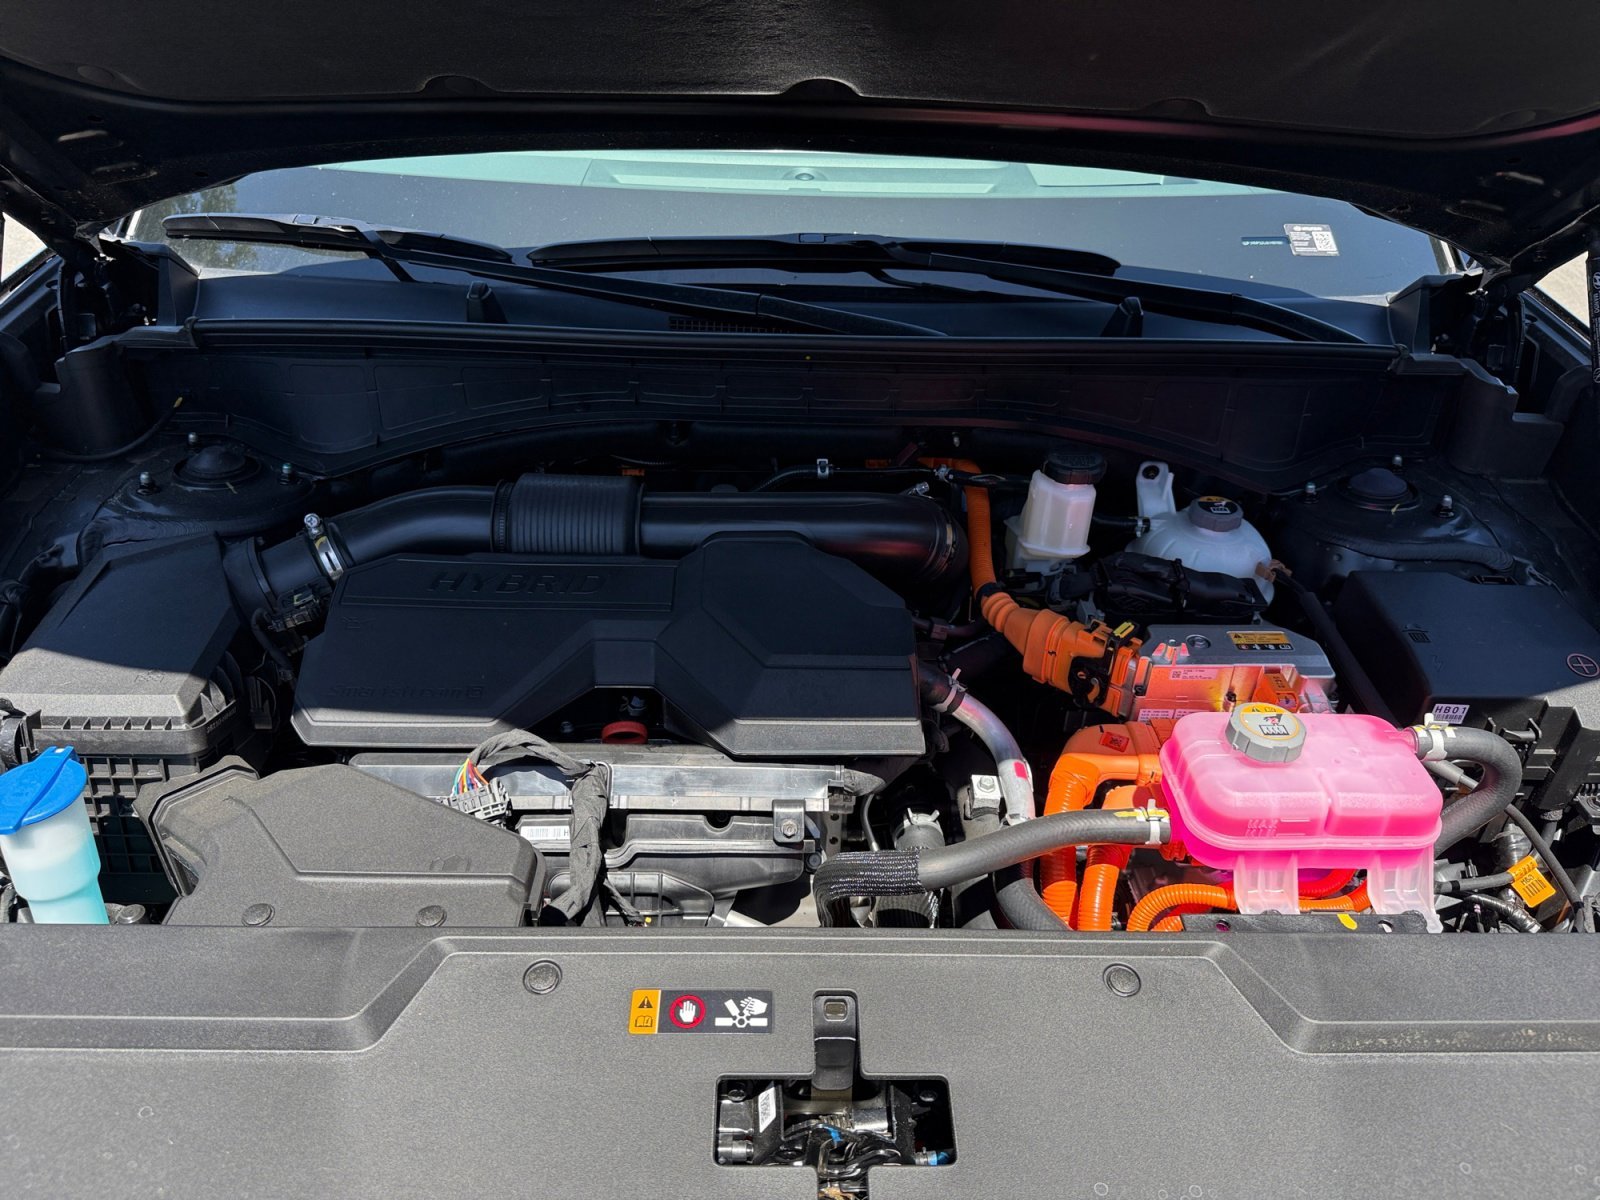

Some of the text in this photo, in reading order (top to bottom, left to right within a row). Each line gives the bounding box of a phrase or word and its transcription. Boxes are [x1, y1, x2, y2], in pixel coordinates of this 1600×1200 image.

[426, 570, 607, 595] HYBRID
[1435, 705, 1467, 714] HB01
[1248, 818, 1277, 828] MAX
